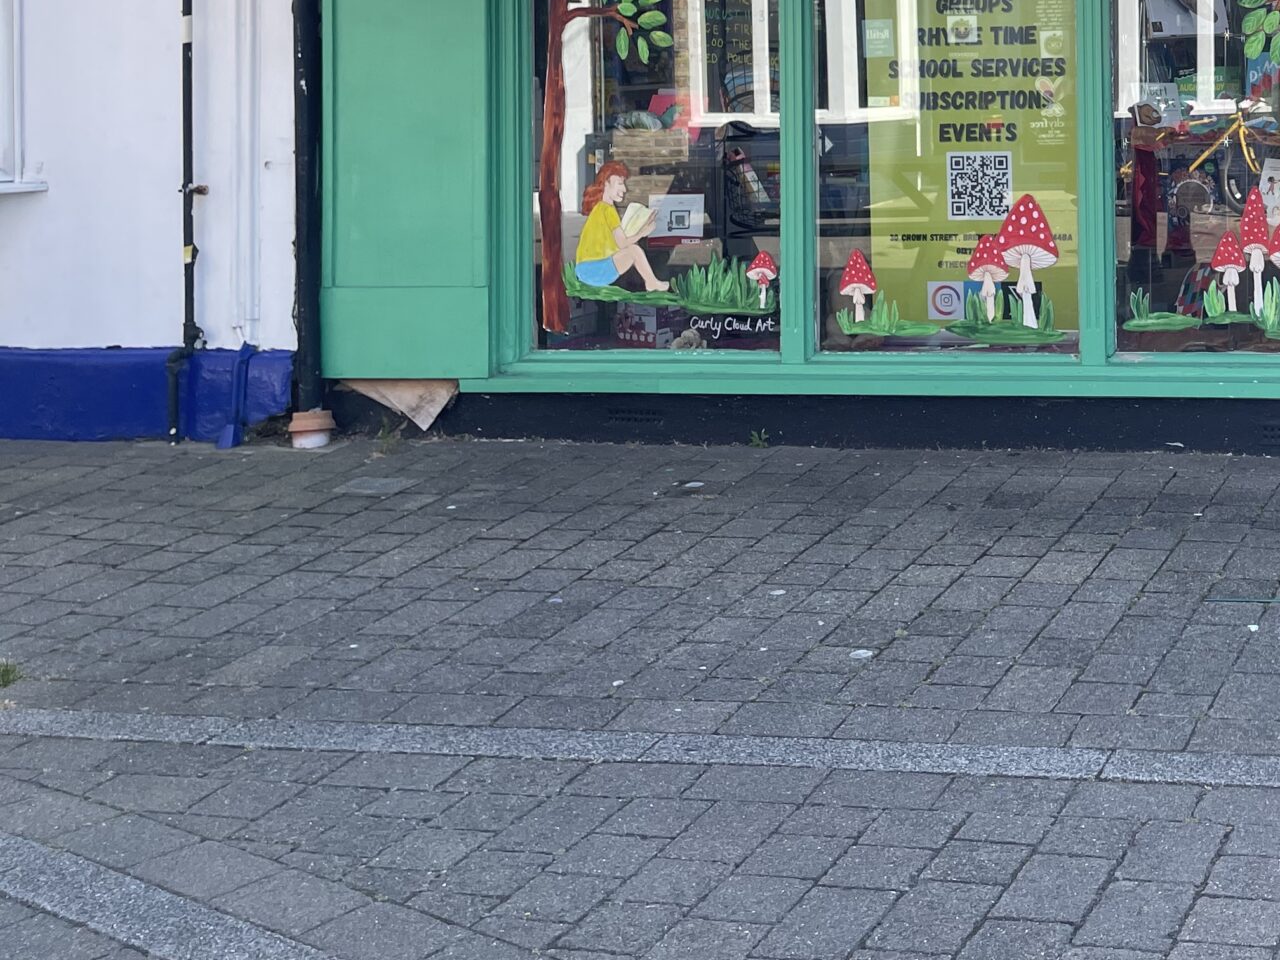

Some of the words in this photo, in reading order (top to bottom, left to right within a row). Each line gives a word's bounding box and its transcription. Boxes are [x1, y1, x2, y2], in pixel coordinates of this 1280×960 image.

[916, 25, 983, 47] RHYE
[990, 25, 1037, 46] TIME
[888, 58, 963, 80] SHOOL
[970, 57, 1066, 78] SERVICES
[938, 122, 1018, 143] EVENTS
[901, 233, 928, 242] CROWN
[690, 316, 722, 339] Curly
[724, 317, 752, 332] Cloud
[755, 316, 776, 331] Art
